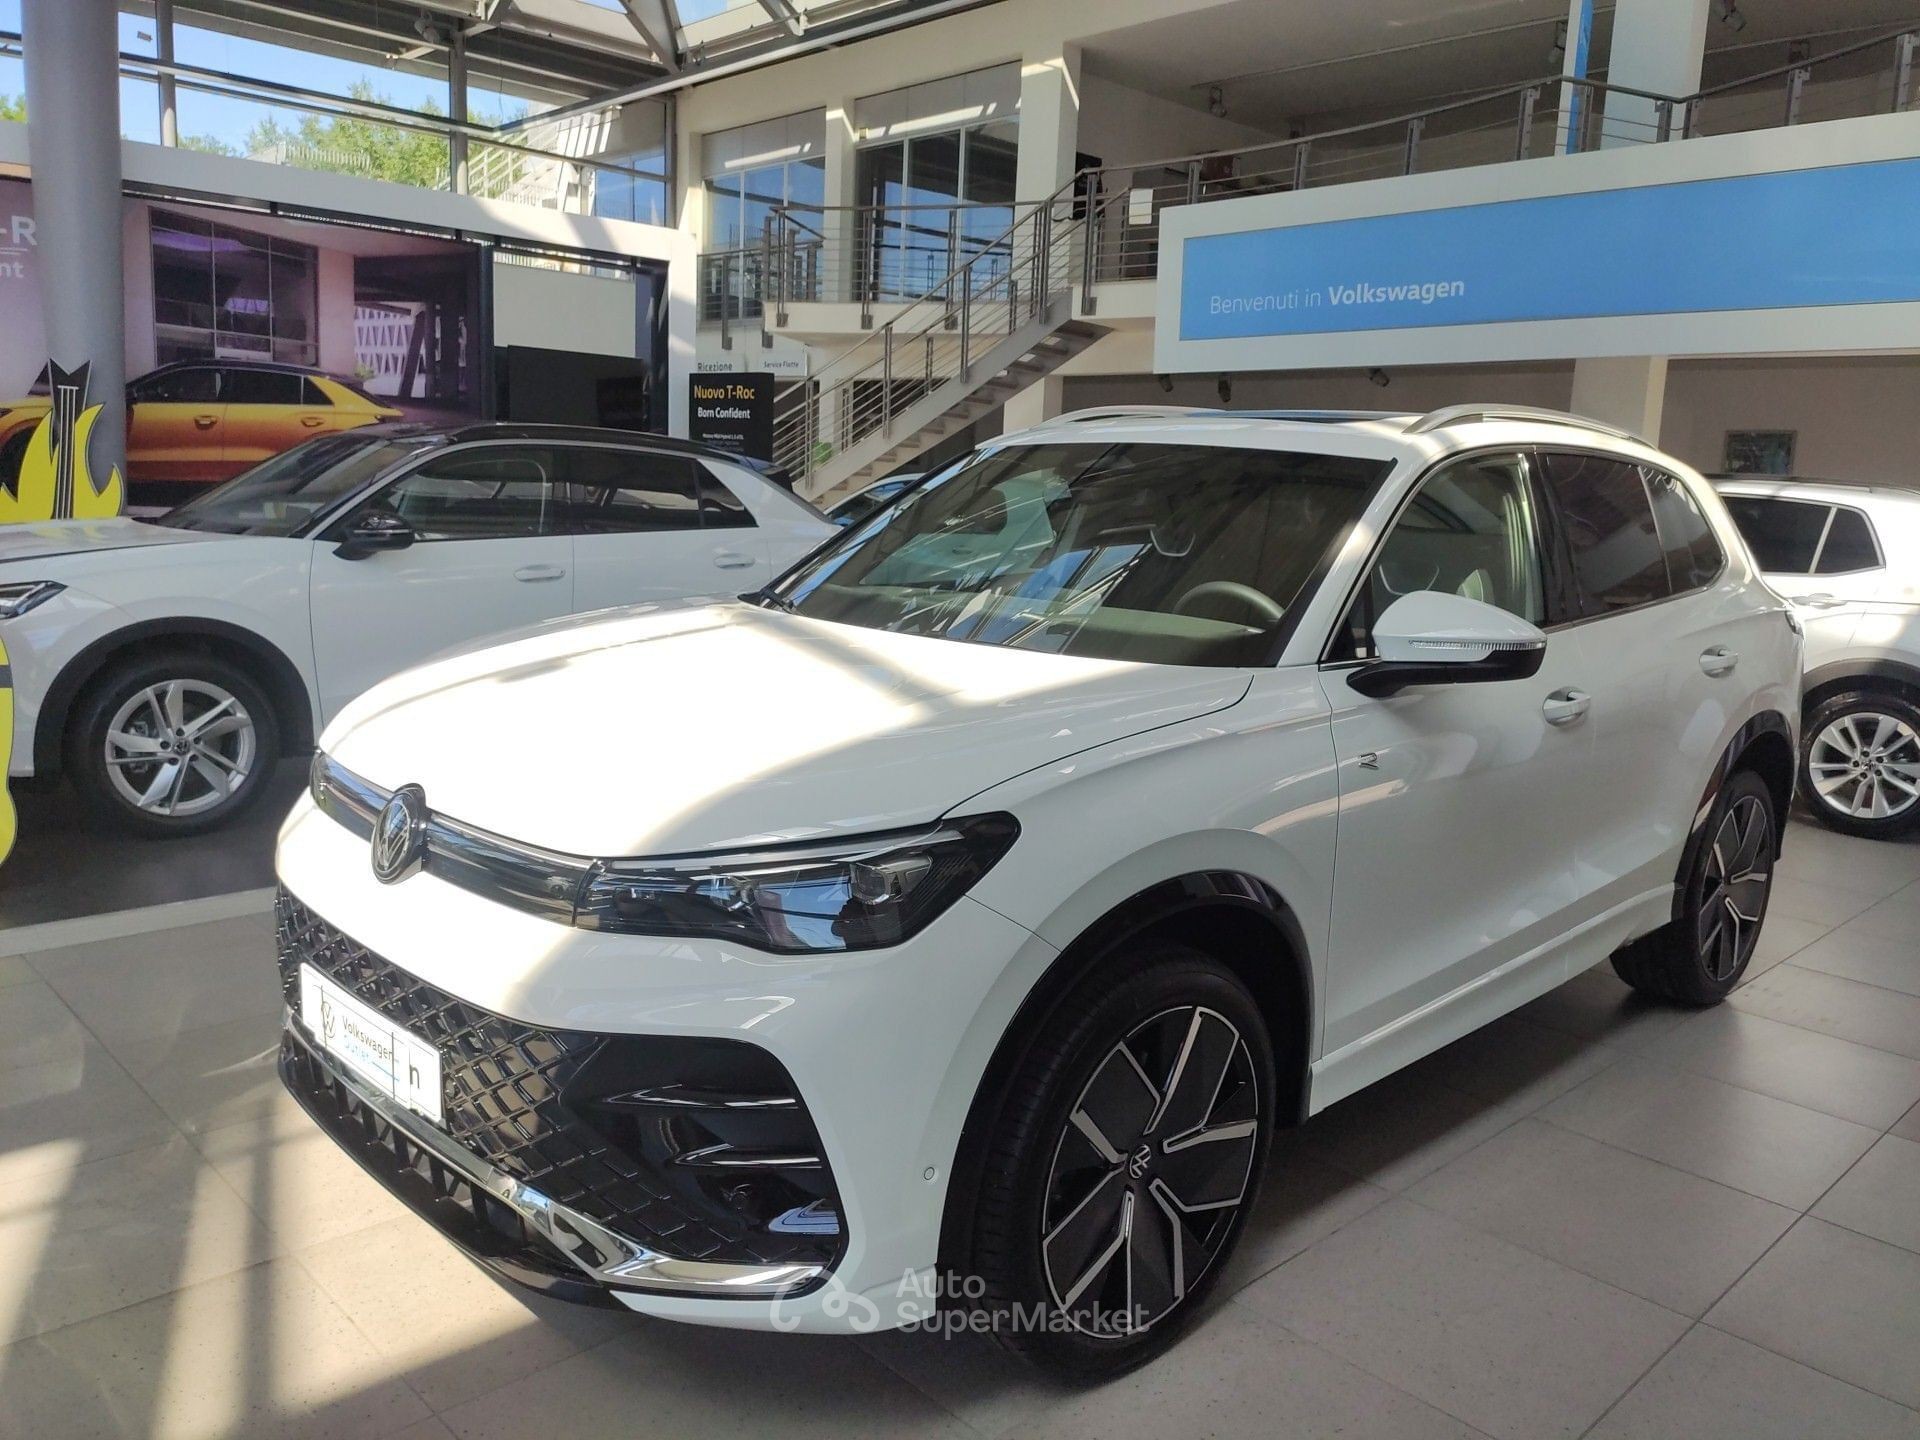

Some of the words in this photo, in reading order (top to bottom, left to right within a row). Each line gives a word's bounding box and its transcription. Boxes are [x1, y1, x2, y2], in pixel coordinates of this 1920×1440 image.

[1209, 288, 1299, 315] Benvenuti
[1304, 288, 1321, 309] in
[1328, 279, 1465, 306] Volkswagen
[697, 362, 733, 372] Ricezione
[694, 384, 725, 399] Nuovo
[726, 384, 755, 400] T-Roc
[697, 406, 714, 418] Born
[715, 406, 751, 420] Confident
